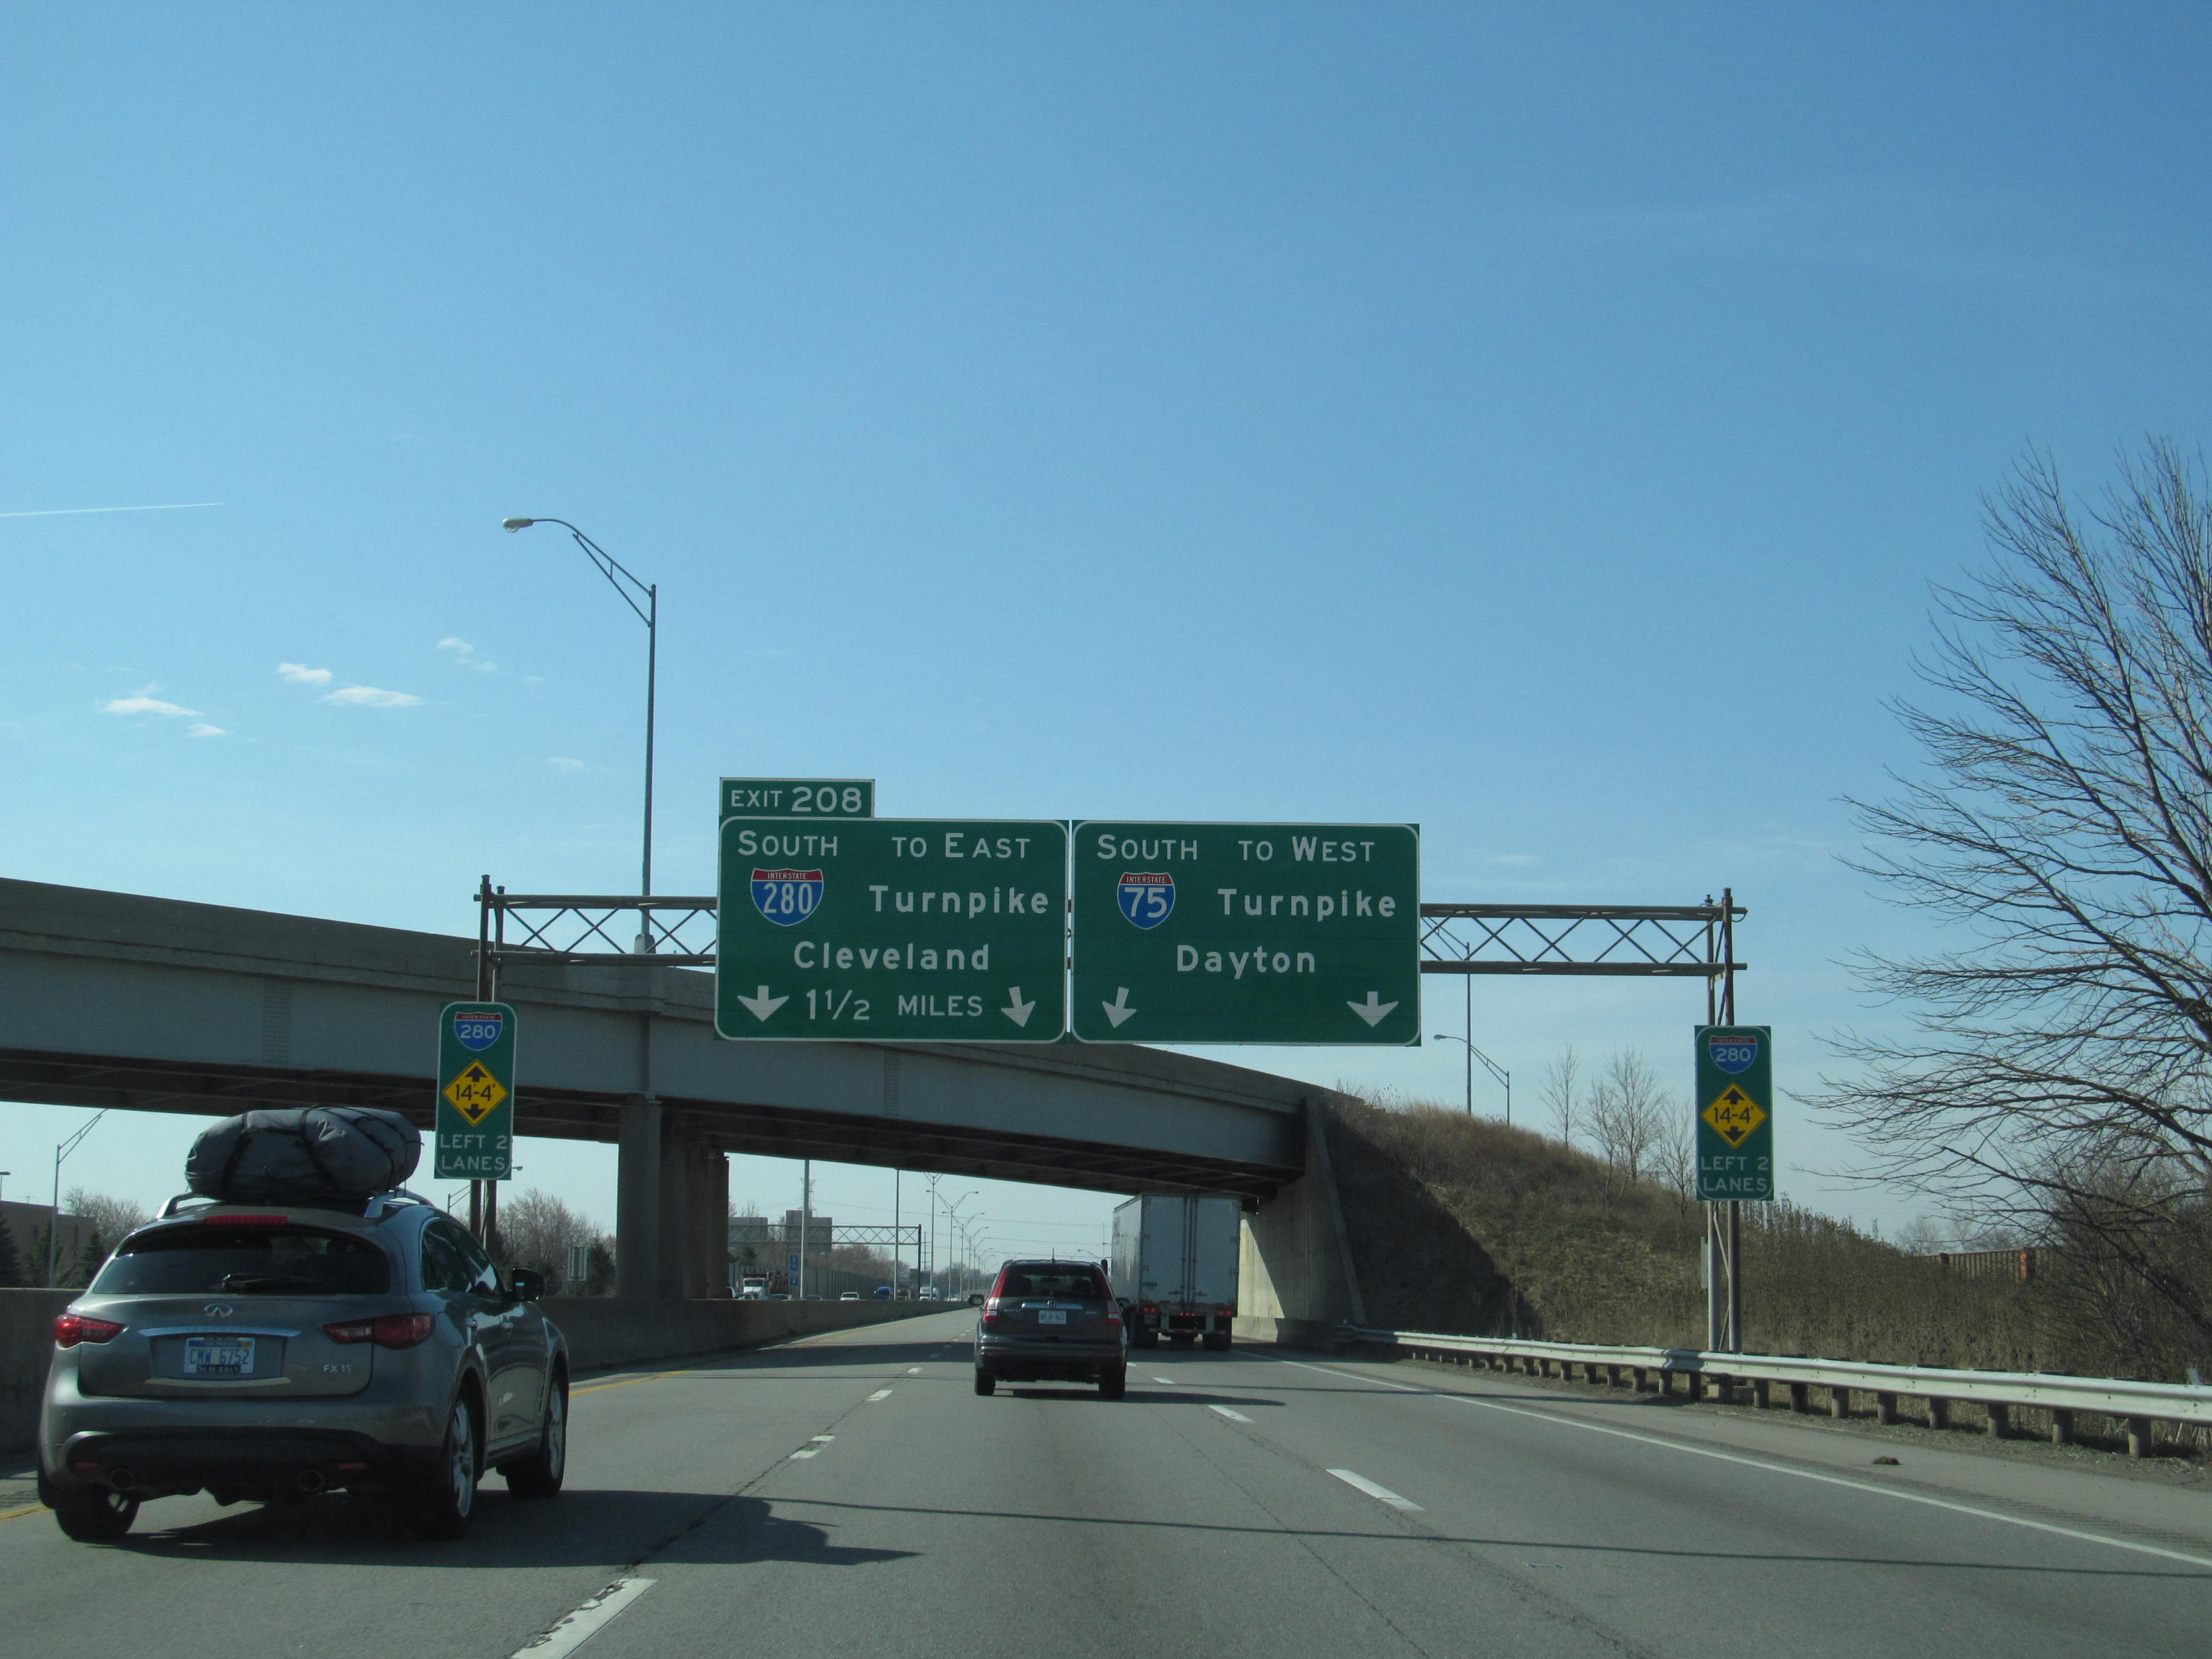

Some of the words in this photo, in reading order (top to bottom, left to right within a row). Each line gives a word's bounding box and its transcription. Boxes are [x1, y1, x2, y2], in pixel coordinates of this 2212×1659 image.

[731, 790, 783, 808] EXIT
[791, 787, 862, 812] 208
[737, 830, 838, 856] SOUTH
[891, 837, 927, 858] TO
[945, 833, 1030, 858] EAST
[1097, 834, 1198, 860] SOUTH
[1238, 840, 1273, 861] TO
[1292, 836, 1375, 862] WEST
[763, 883, 812, 914] 280
[869, 885, 1048, 918] Turnpike
[1125, 887, 1166, 917] 75
[1218, 889, 1395, 922] Turnpike
[794, 941, 989, 971] Cleveland
[1177, 945, 1316, 979] Dayton
[899, 995, 982, 1017] MILES
[460, 1025, 495, 1039] 280
[1717, 1048, 1750, 1061] 280
[441, 1135, 486, 1148] LEFT
[496, 1136, 507, 1149] 2
[441, 1156, 505, 1171] LANES
[1701, 1156, 1748, 1170] LEFT
[1758, 1157, 1768, 1170] 2
[1704, 1178, 1766, 1192] LANES
[219, 1349, 249, 1364] 6752
